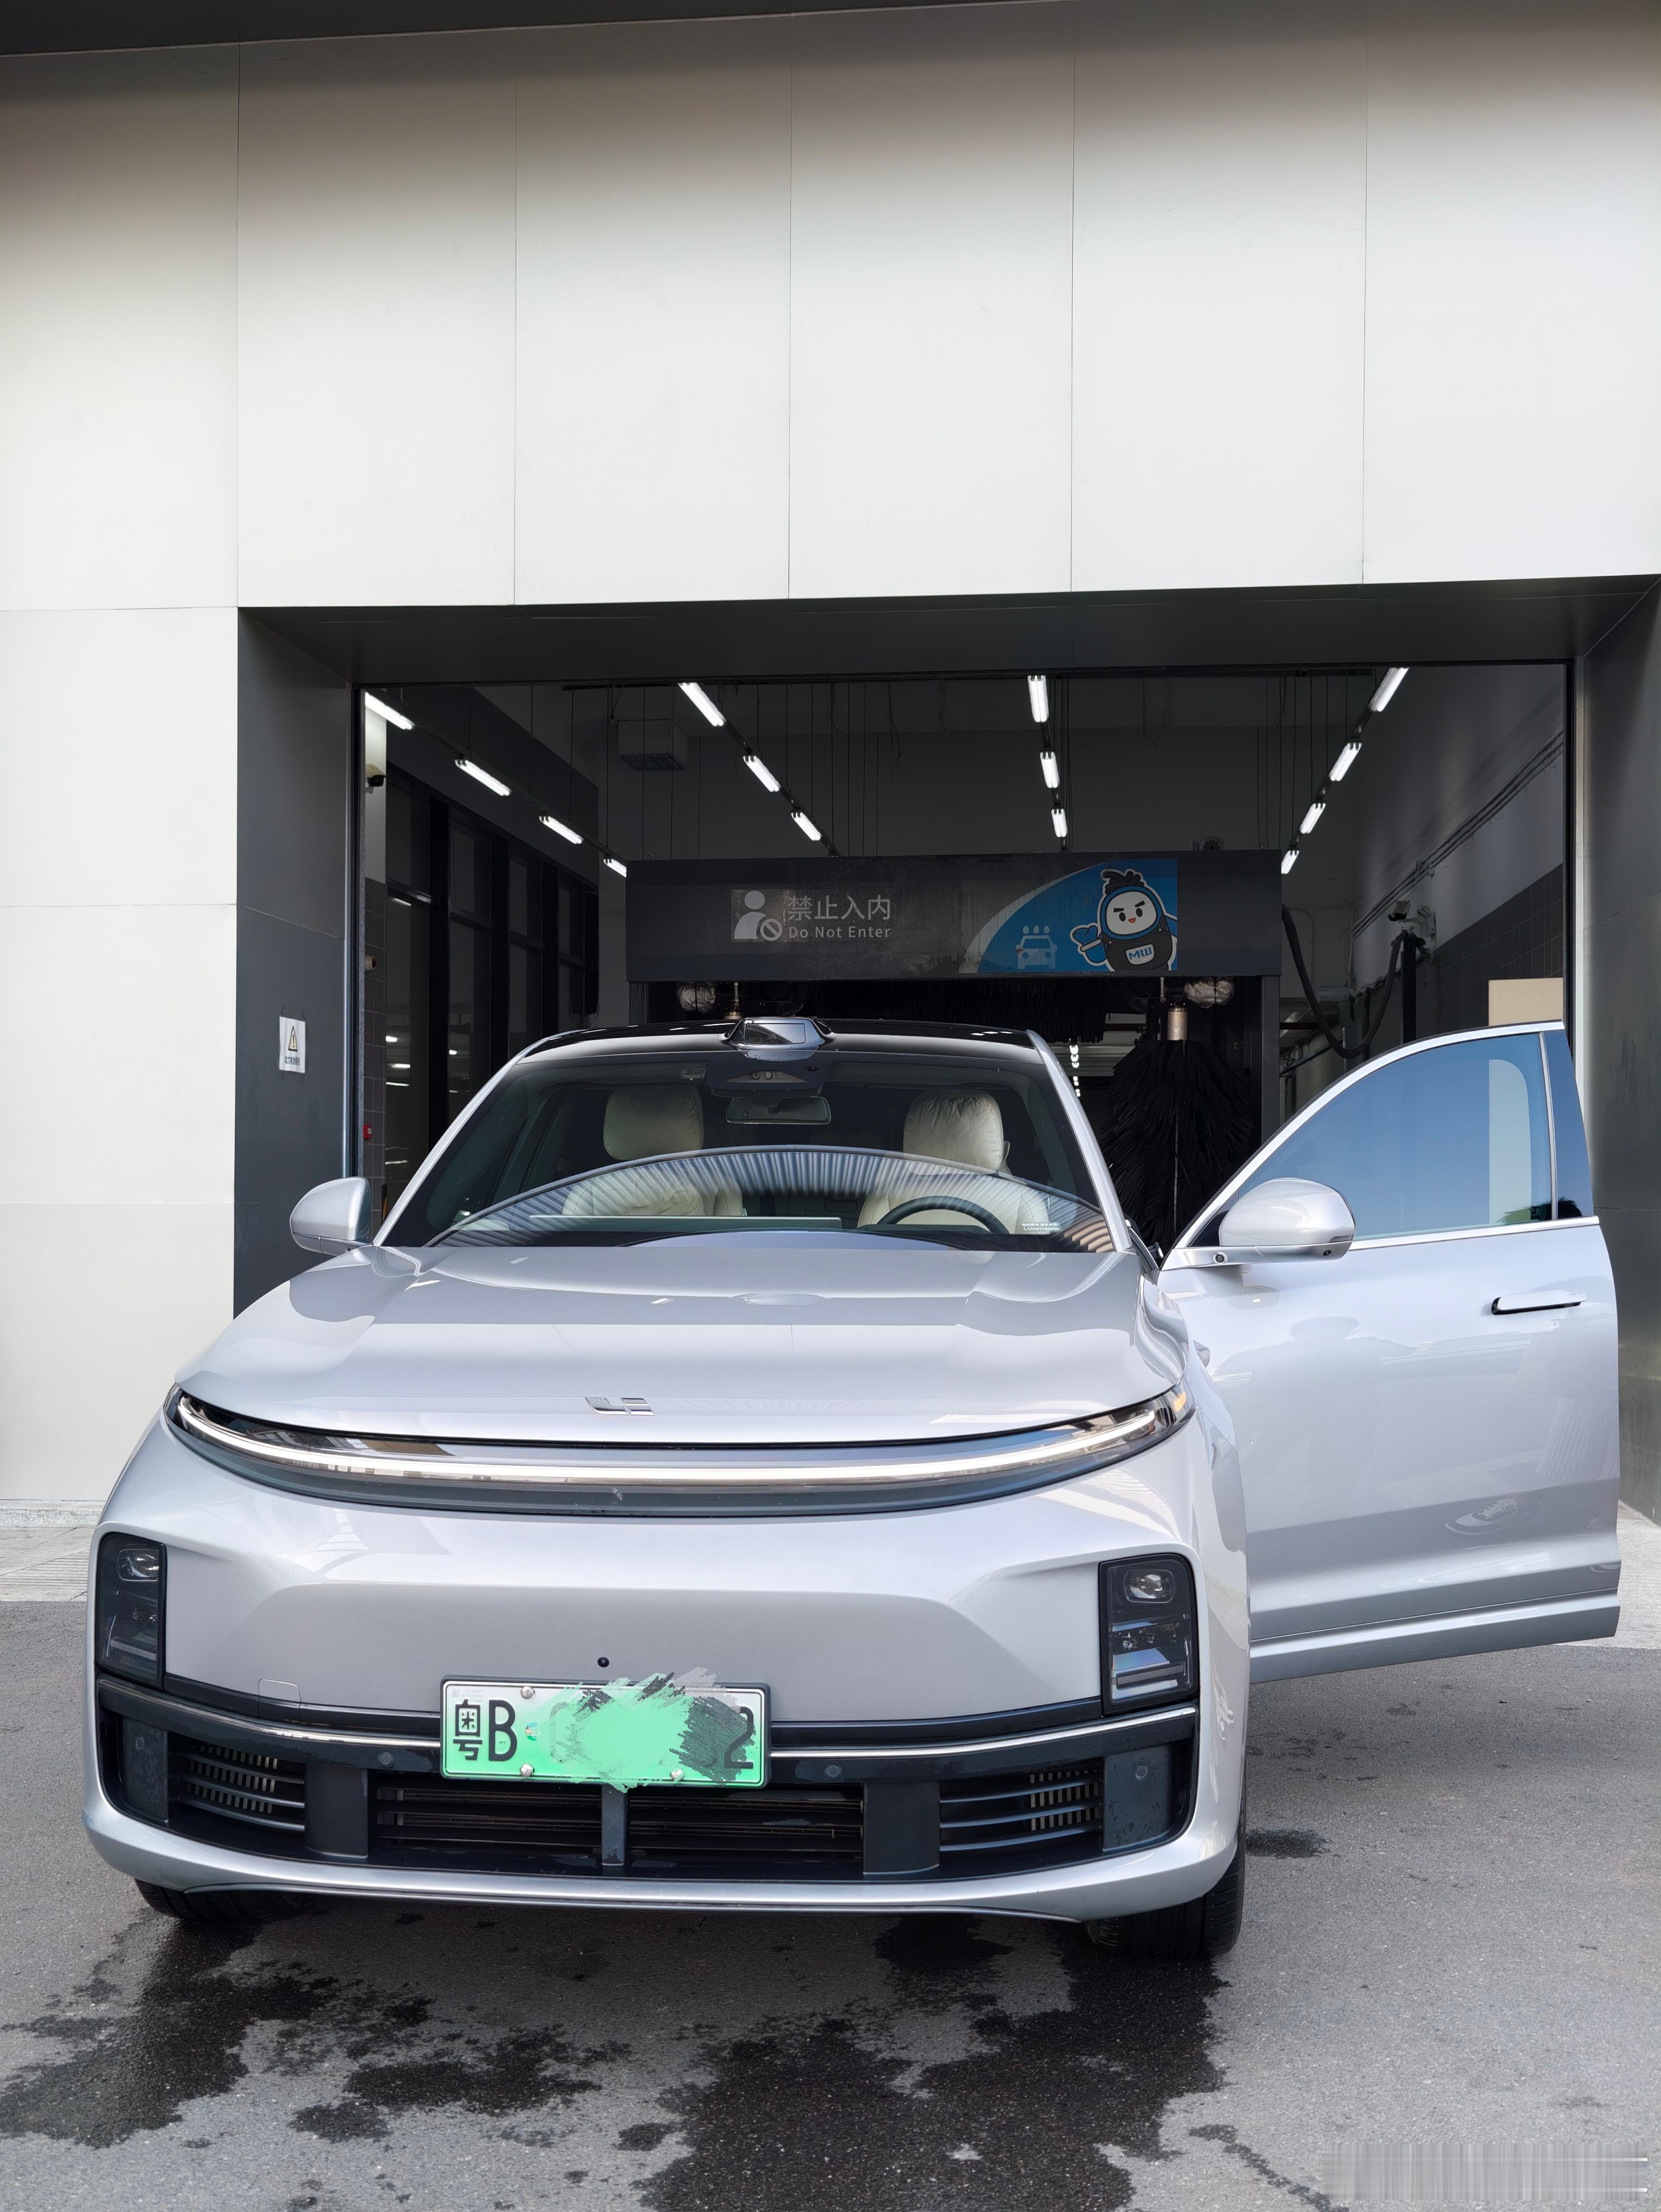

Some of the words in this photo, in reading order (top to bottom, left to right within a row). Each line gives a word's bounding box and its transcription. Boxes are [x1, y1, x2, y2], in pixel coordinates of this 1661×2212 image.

[787, 895, 891, 921] 禁止入内
[789, 926, 809, 938] Do
[815, 925, 842, 938] Not
[848, 925, 891, 938] Enter
